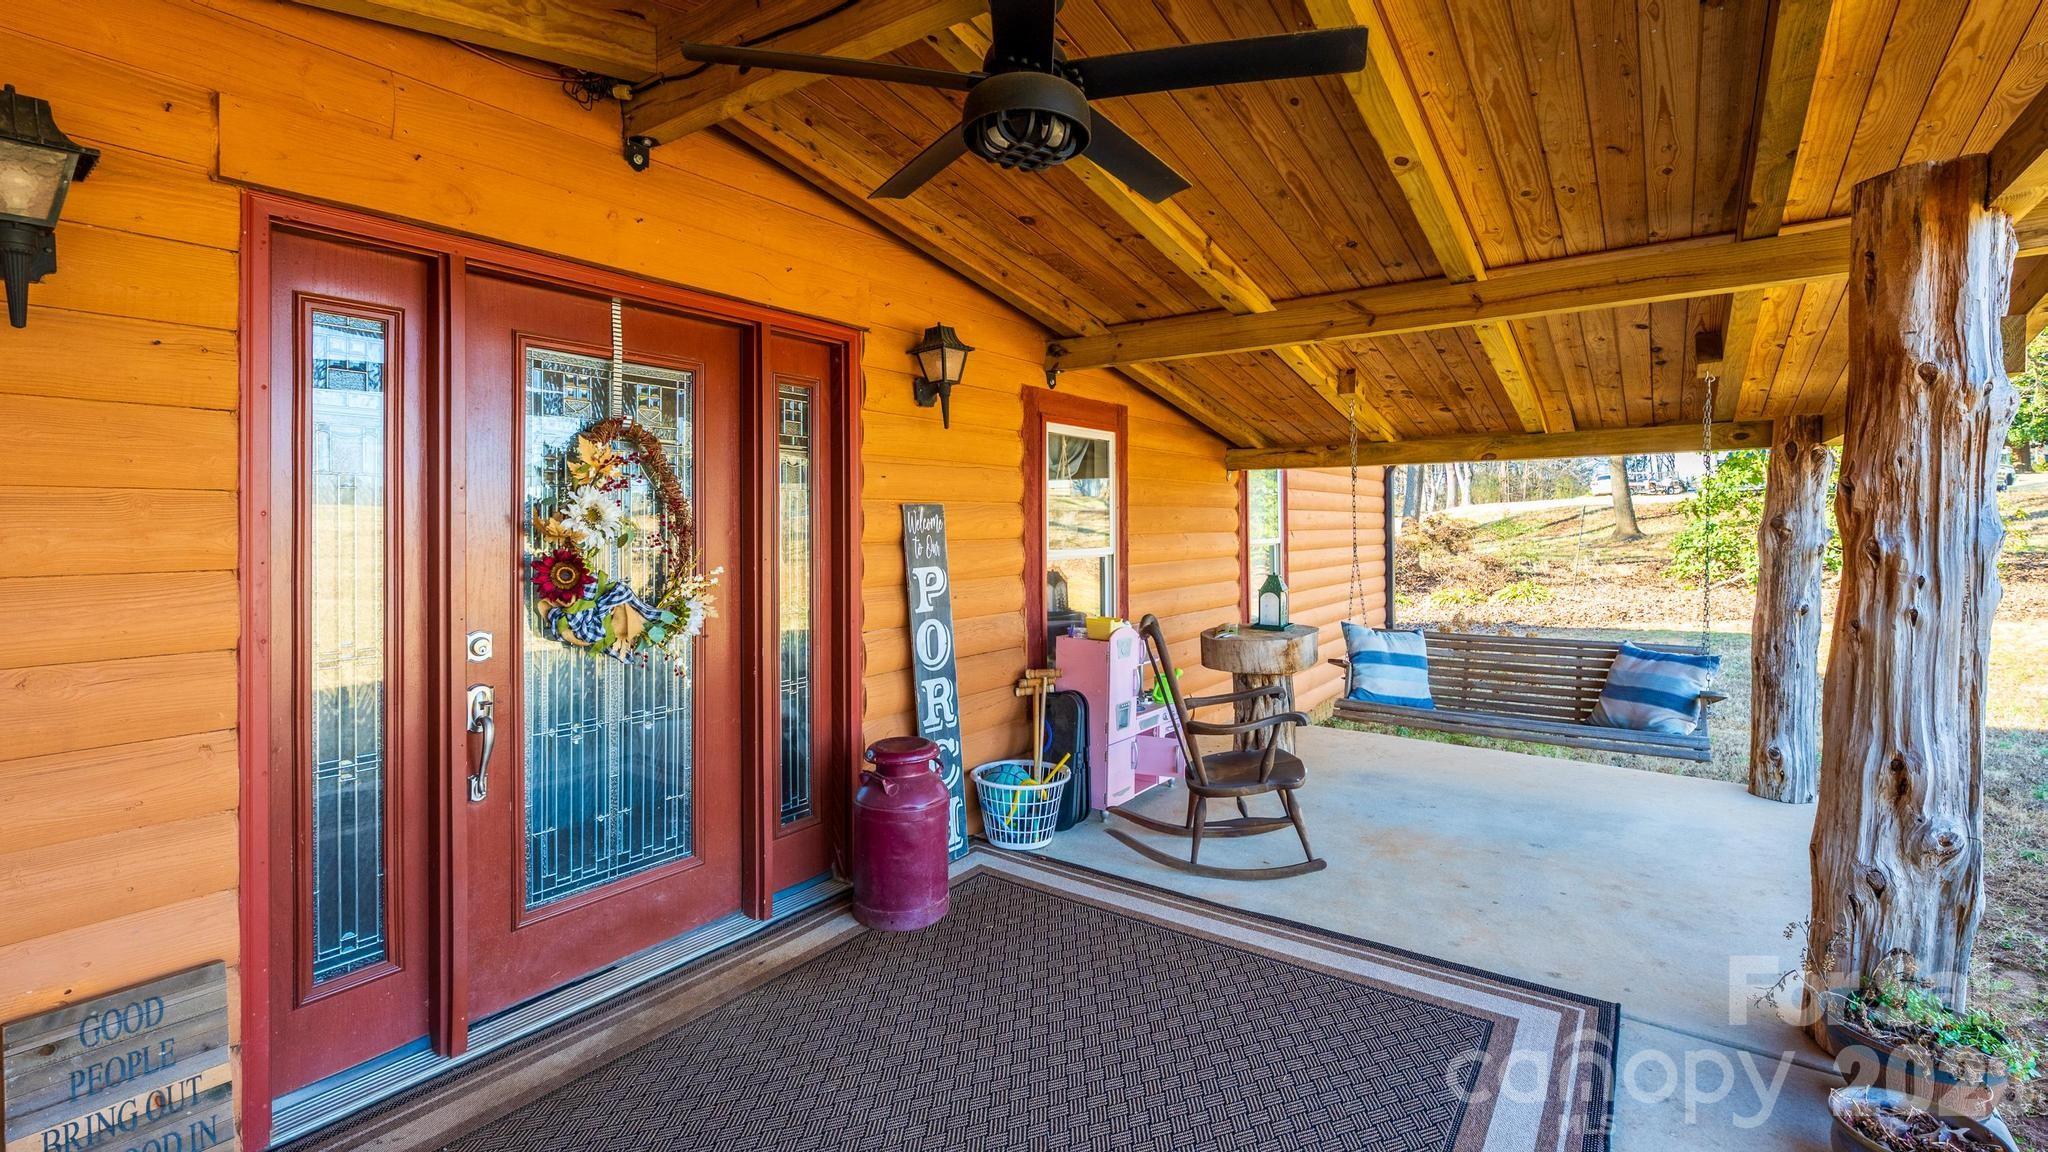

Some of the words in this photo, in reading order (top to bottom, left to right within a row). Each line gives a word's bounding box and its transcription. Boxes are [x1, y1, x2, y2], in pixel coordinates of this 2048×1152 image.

[907, 506, 944, 535] Welcome
[912, 536, 923, 560] to
[78, 995, 165, 1049] GOOD
[68, 1037, 177, 1103] PEOPLE
[40, 1099, 138, 1152] BRING
[145, 1074, 203, 1122] OUT
